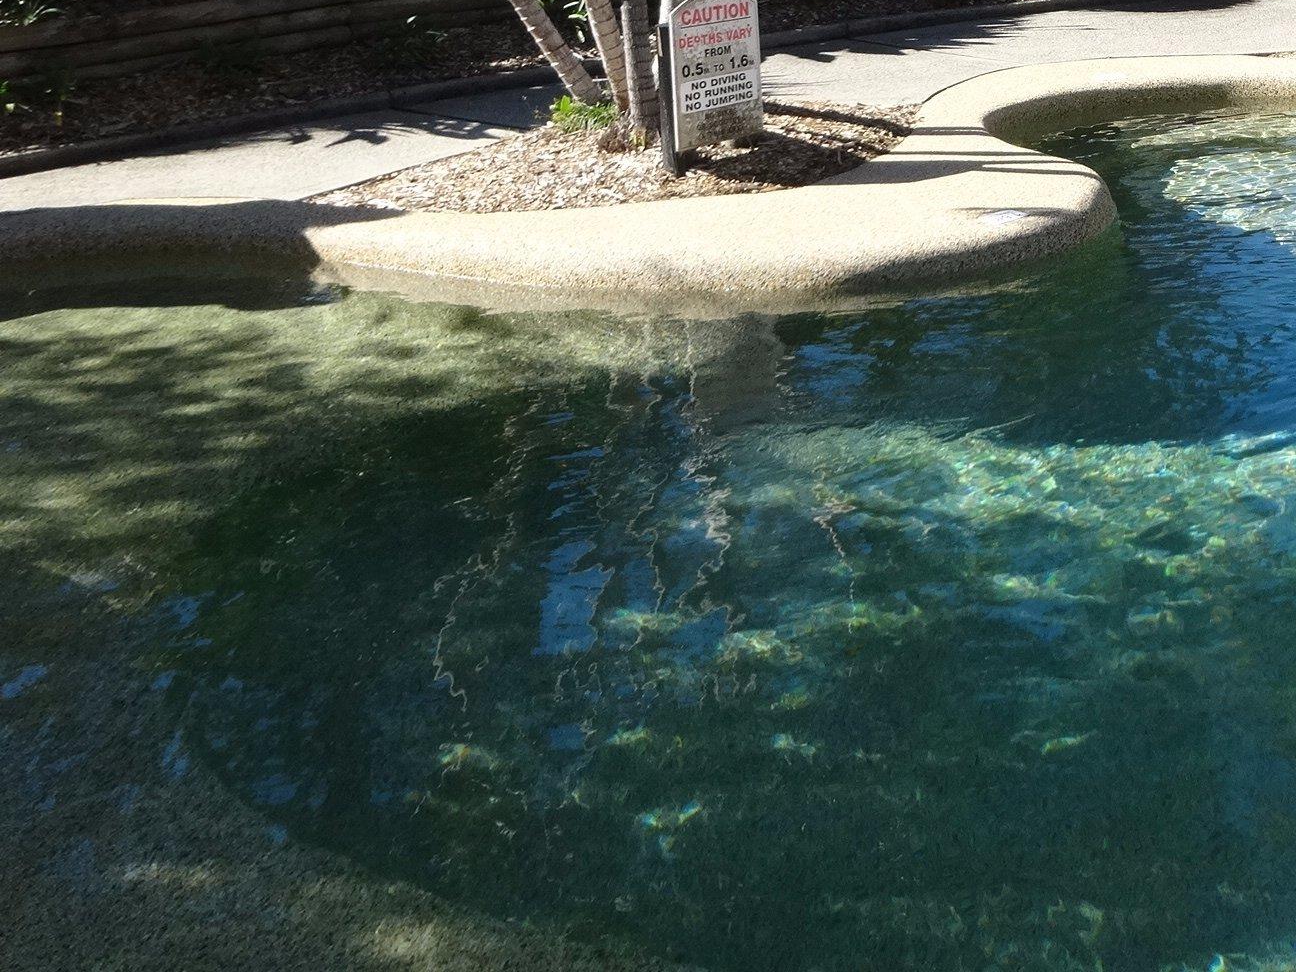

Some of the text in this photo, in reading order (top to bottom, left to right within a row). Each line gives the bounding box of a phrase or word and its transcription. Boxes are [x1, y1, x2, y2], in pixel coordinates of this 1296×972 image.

[681, 2, 749, 25] CAUTION
[726, 27, 753, 41] VARY
[705, 45, 731, 57] FROM
[714, 63, 725, 72] TO
[691, 72, 746, 90] NO DIVING
[685, 81, 753, 102] NO RUNNING
[685, 90, 753, 112] NO JUMPING
